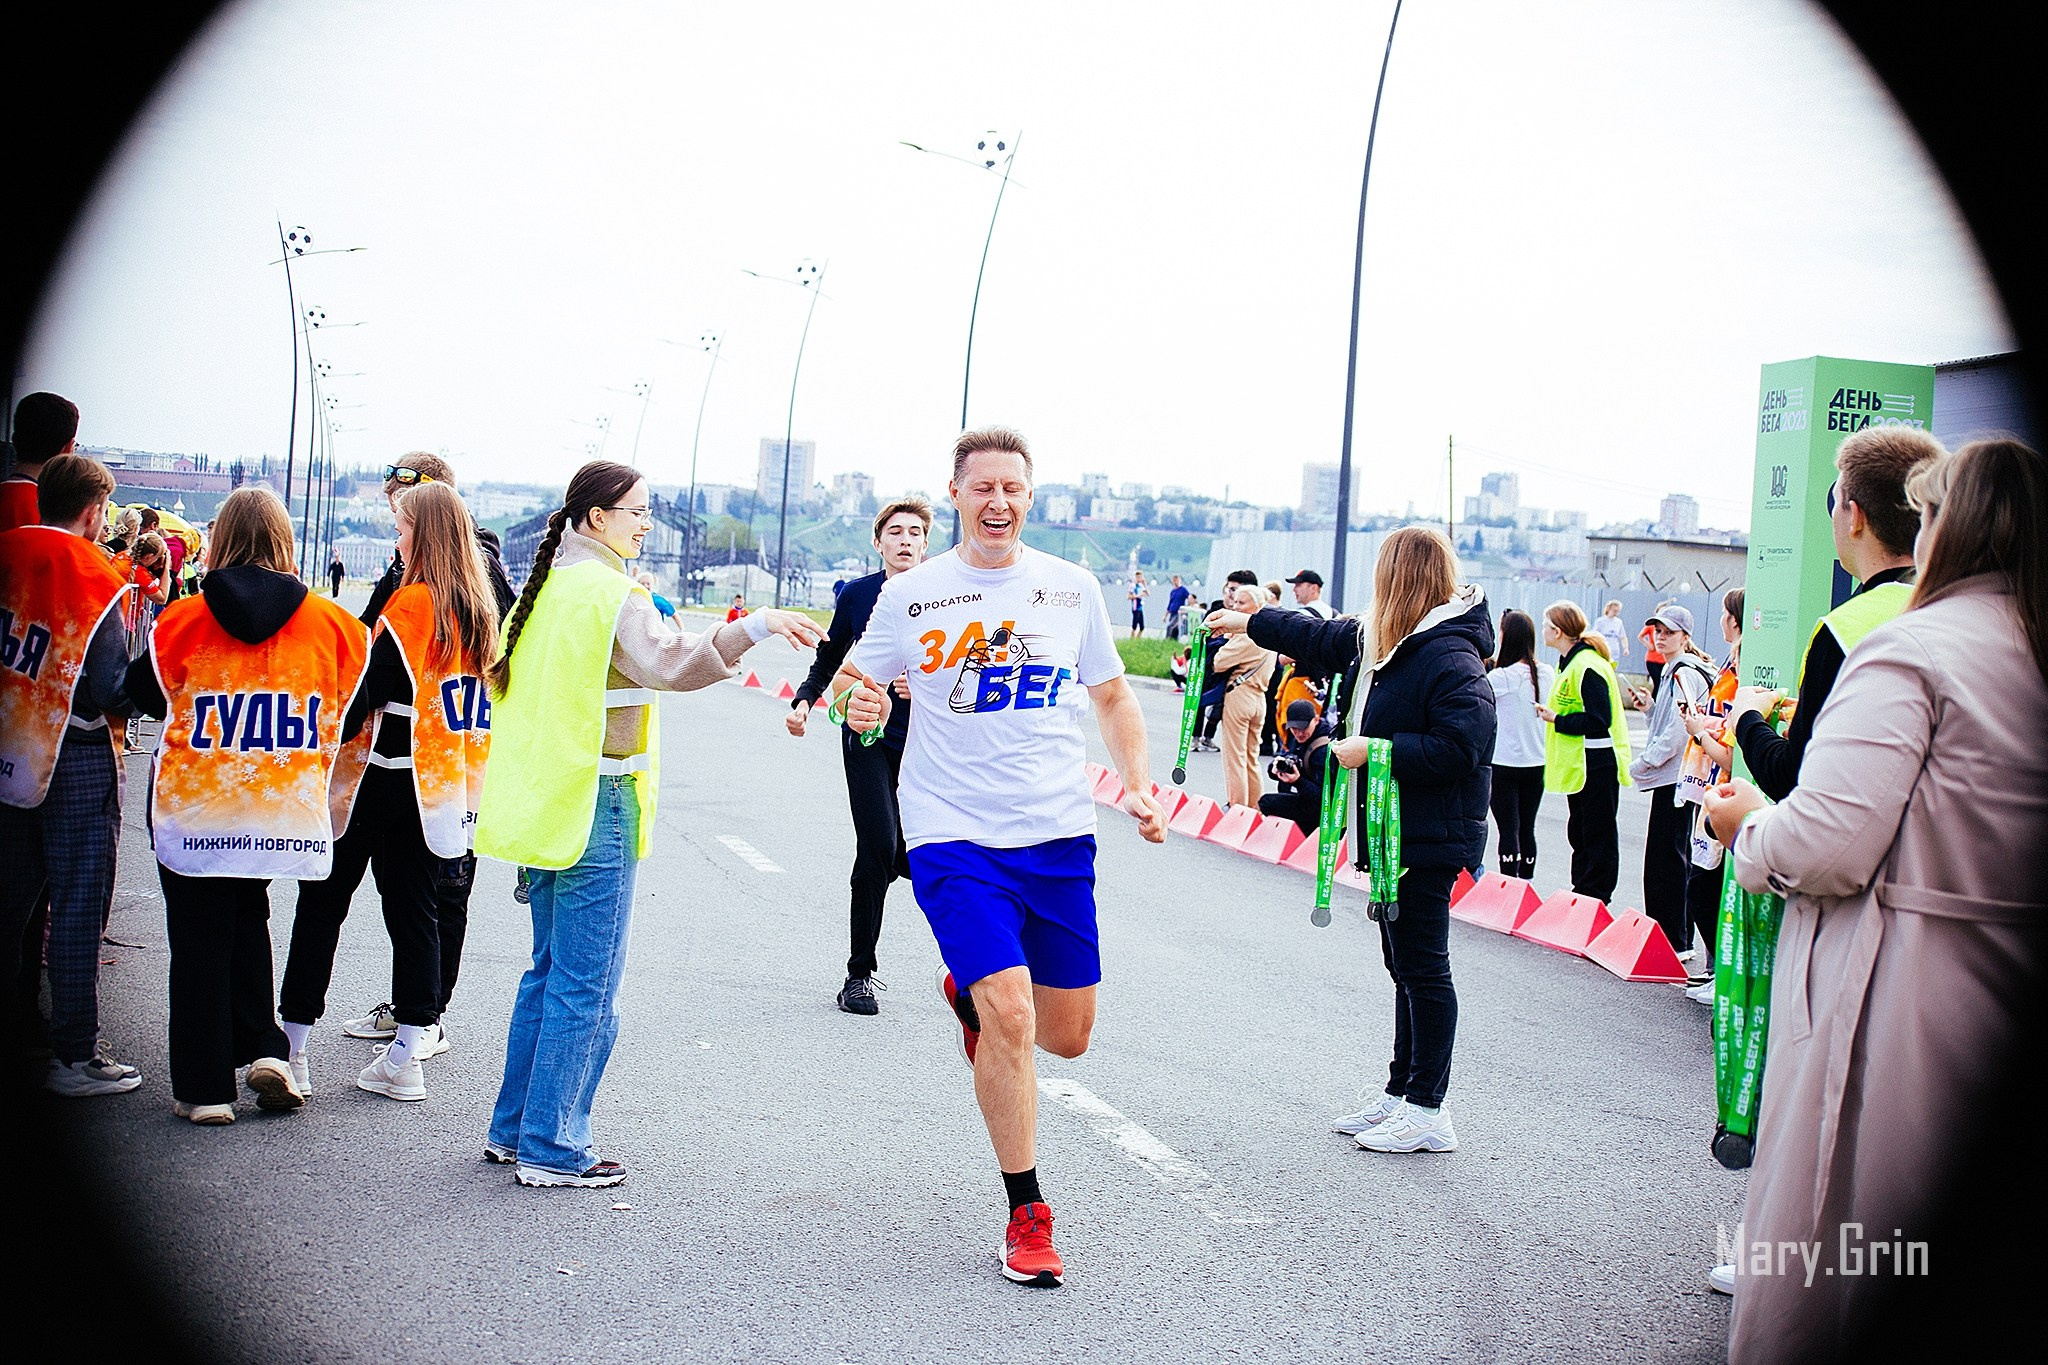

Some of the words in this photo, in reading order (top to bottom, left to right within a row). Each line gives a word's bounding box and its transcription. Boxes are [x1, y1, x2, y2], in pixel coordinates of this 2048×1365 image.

[1762, 389, 1788, 412] ДЕНЬ
[1829, 388, 1882, 411] ДЕНЬ
[1761, 413, 1781, 433] БЕГА
[1828, 411, 1871, 433] БЕГА
[924, 593, 982, 611] РОСАТОМ
[1051, 600, 1081, 609] СПОРТ
[1054, 592, 1081, 600] АТОМ
[1754, 666, 1774, 680] СПОРТ
[183, 834, 251, 850] НИЖНИЙ
[254, 837, 327, 856] НОВГОРОД
[1724, 880, 1737, 913] КРОСС
[1721, 922, 1734, 965] НАЦИИ
[1744, 1030, 1761, 1070] БЕГА
[1736, 1071, 1753, 1117] ДЕНЬ
